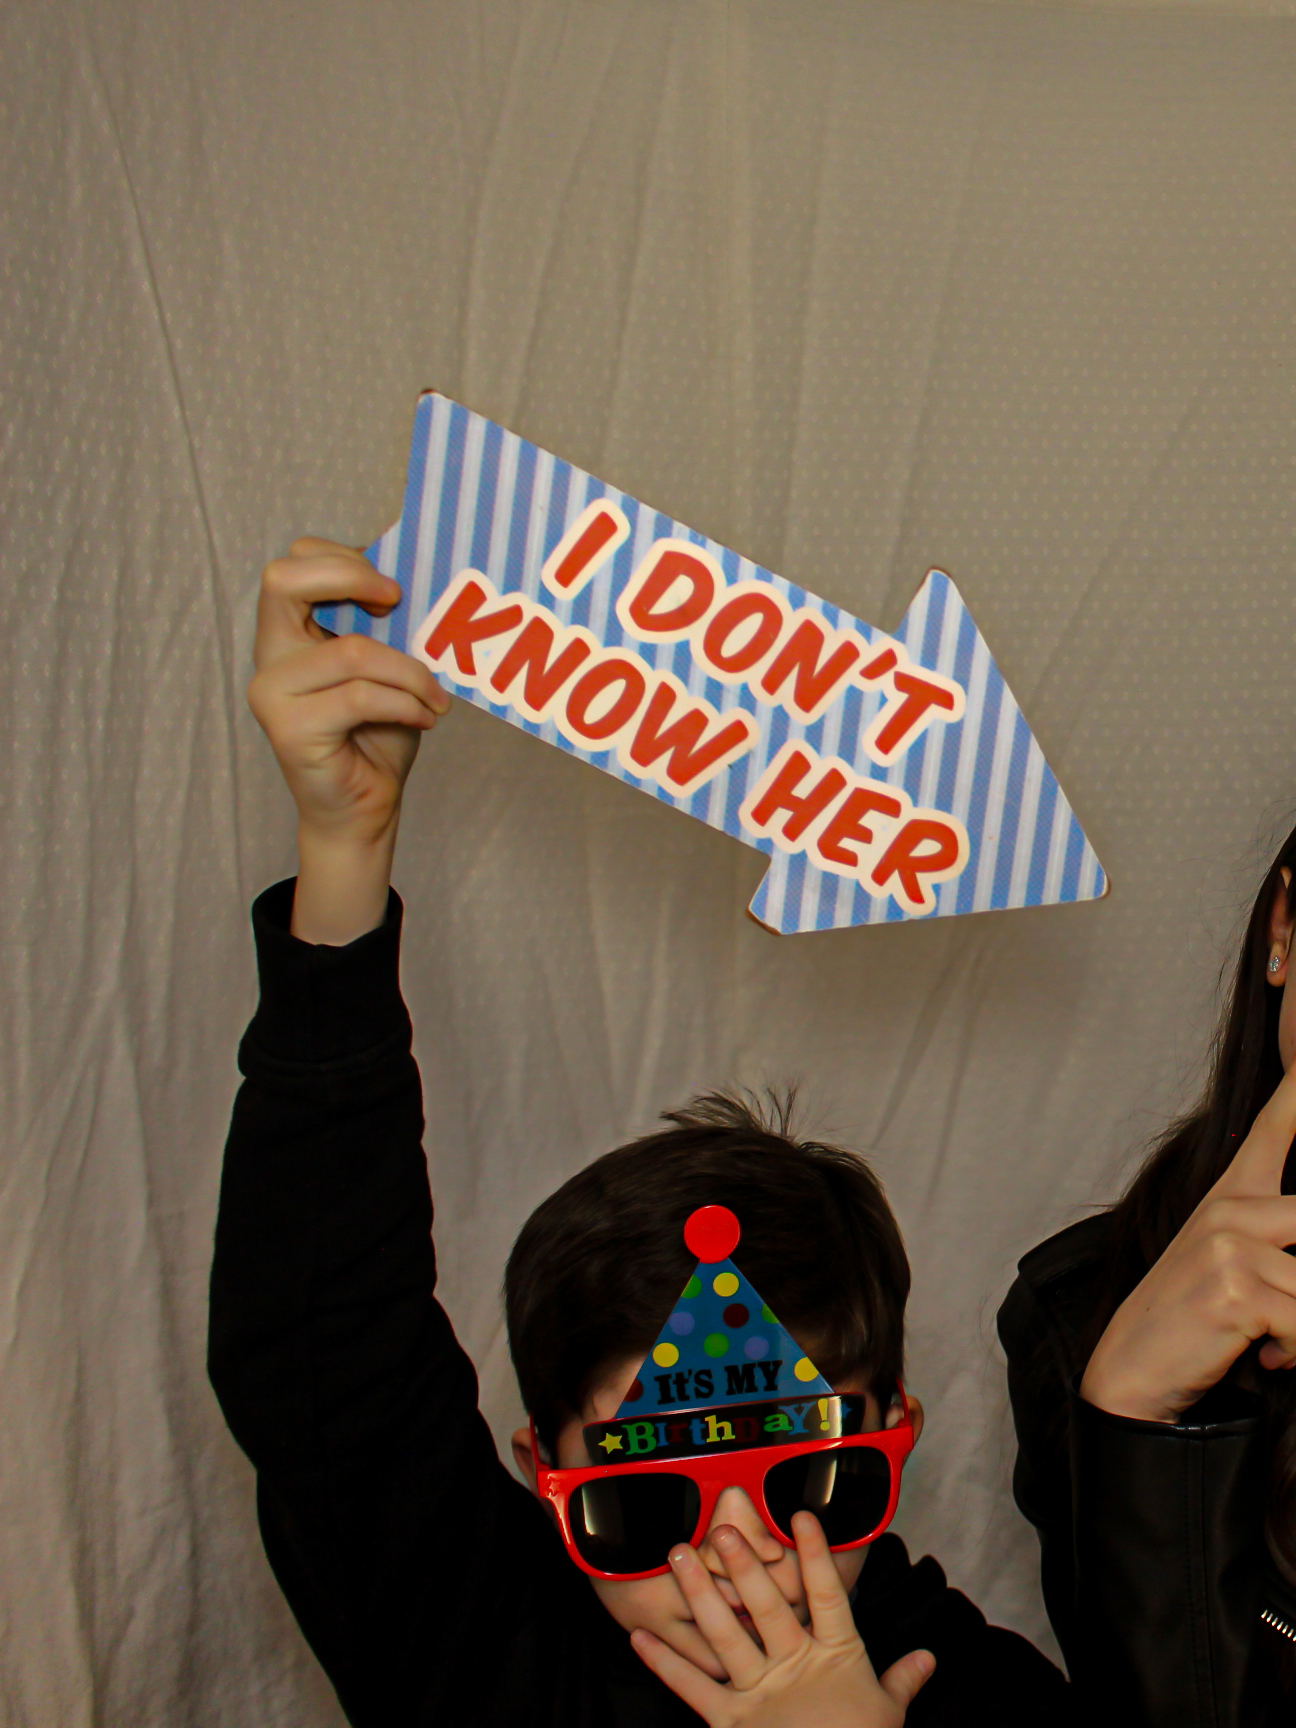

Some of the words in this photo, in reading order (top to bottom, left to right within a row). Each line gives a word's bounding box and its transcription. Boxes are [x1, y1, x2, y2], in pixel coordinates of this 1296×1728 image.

[424, 580, 750, 788] KNOW
[751, 750, 960, 905] HER
[555, 511, 618, 589] I
[629, 550, 956, 755] DON'T
[724, 1360, 783, 1395] MY
